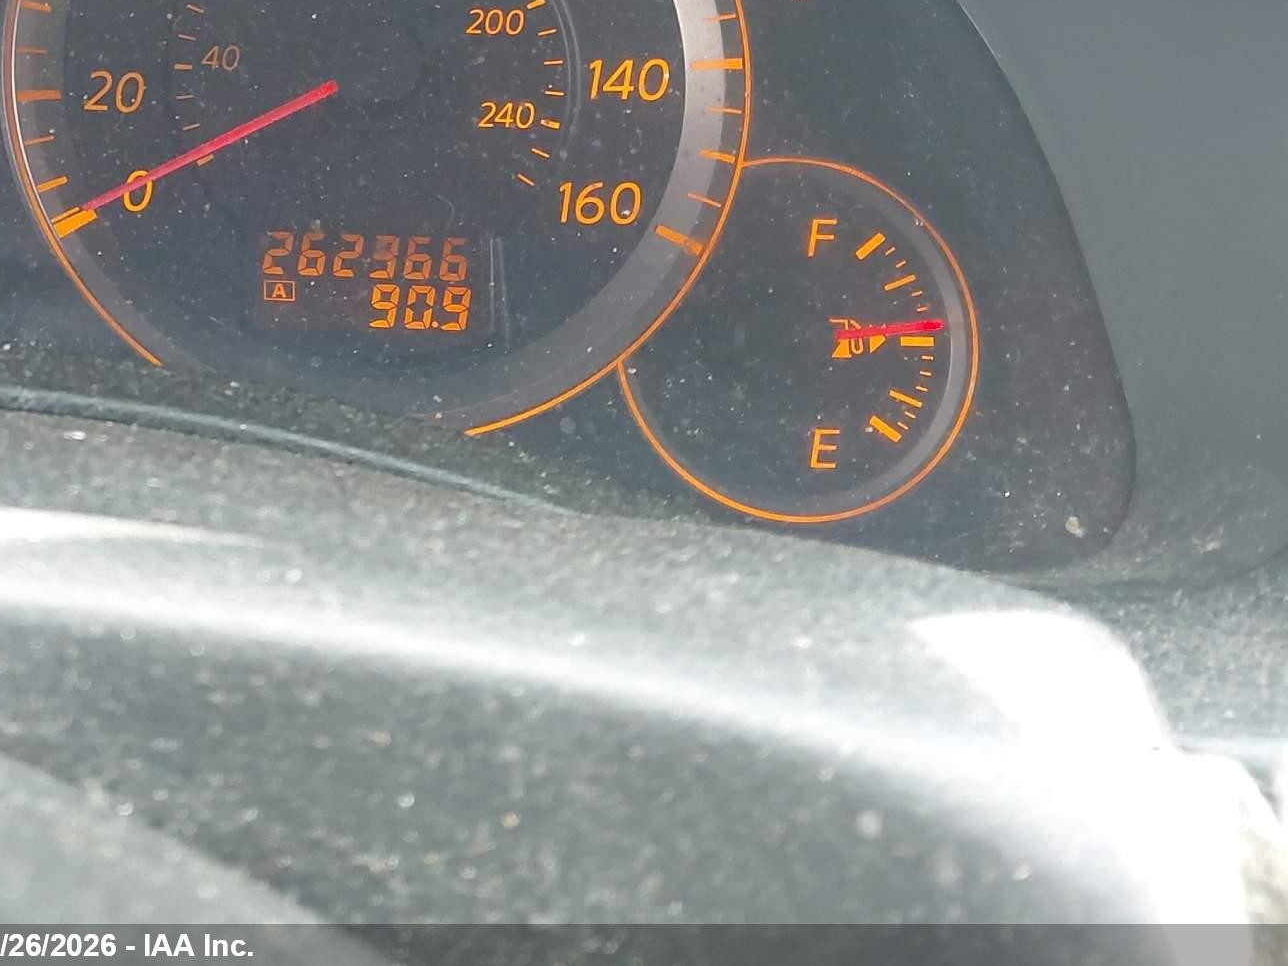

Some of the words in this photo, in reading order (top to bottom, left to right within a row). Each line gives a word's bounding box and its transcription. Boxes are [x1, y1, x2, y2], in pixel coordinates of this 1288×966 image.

[466, 8, 525, 36] 200
[200, 44, 240, 71] 40
[84, 70, 145, 114] 20
[589, 58, 670, 102] 140
[478, 101, 536, 130] 240
[123, 169, 153, 212] 0
[559, 181, 643, 225] 160
[262, 231, 469, 282] 262366
[807, 218, 838, 258] F
[368, 283, 472, 332] 90.9
[809, 428, 841, 470] E
